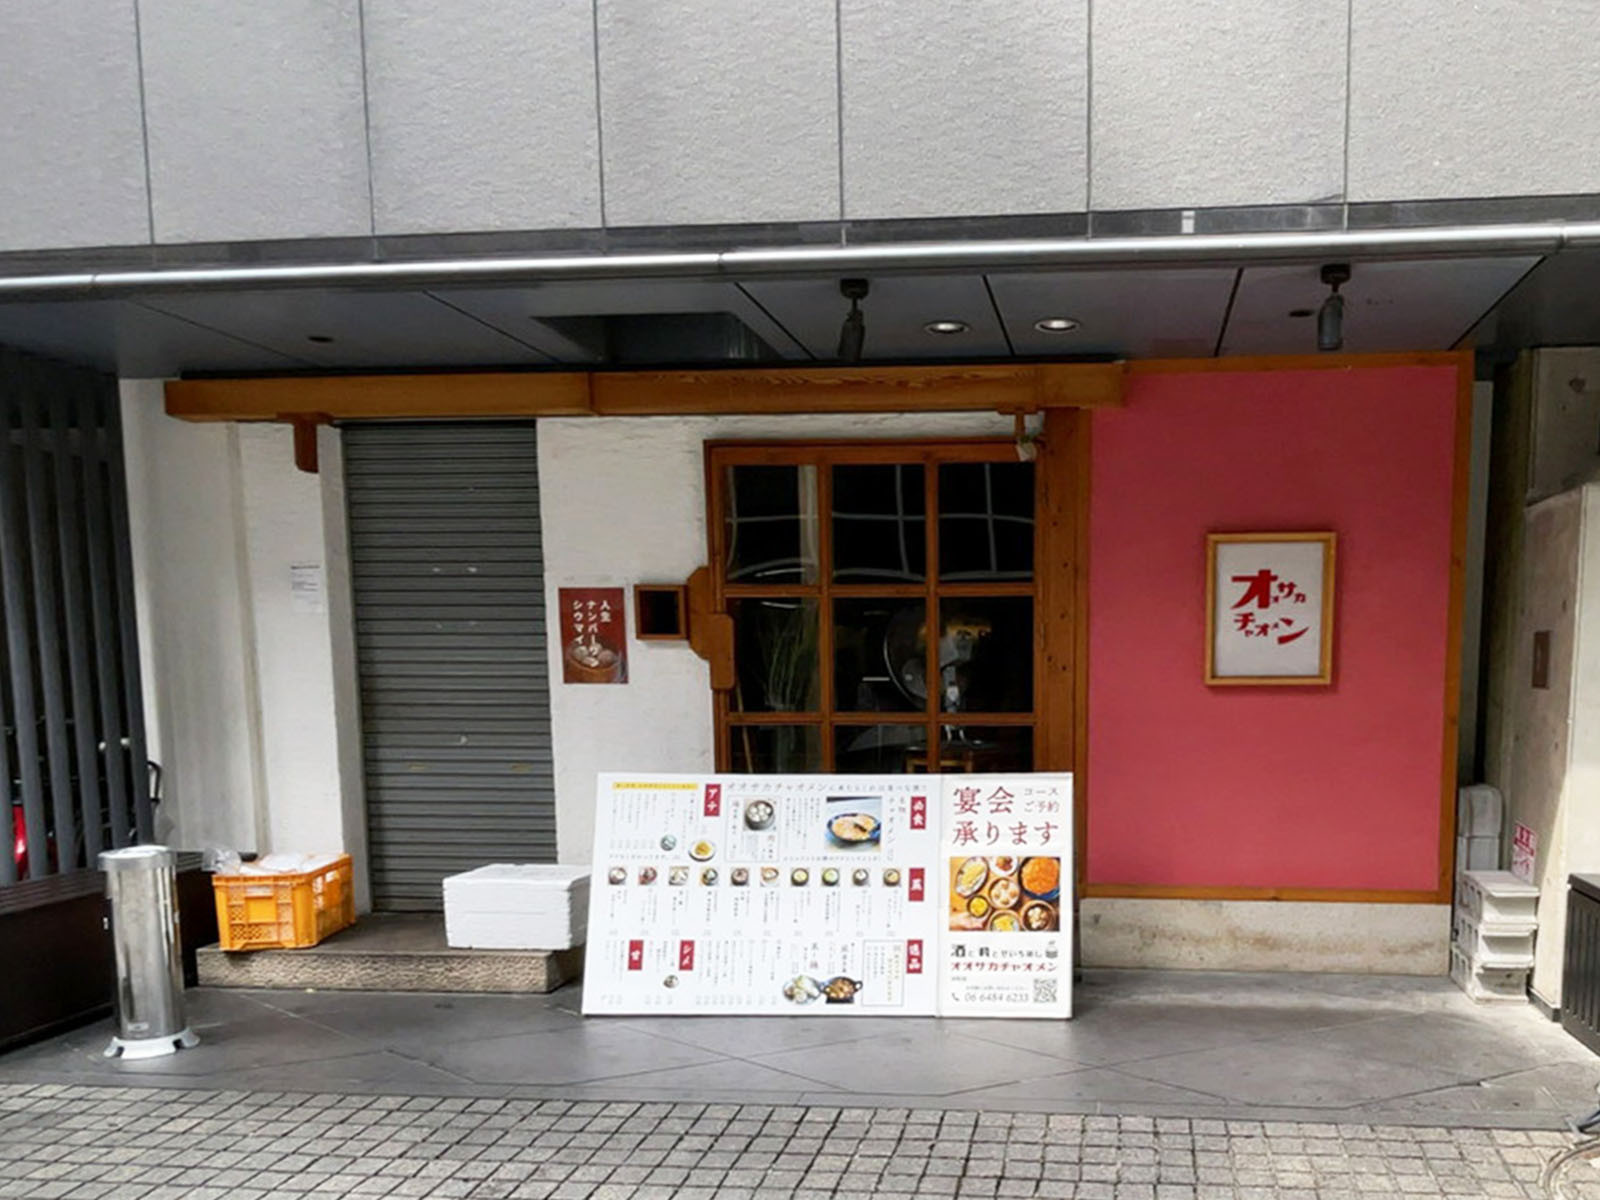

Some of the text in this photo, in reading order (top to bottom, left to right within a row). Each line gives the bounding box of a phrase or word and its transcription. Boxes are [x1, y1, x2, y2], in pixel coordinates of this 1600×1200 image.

[953, 786, 1015, 815] 宴会
[1024, 787, 1059, 796] コース
[1025, 801, 1060, 813] ご予約
[952, 821, 1059, 846] 承ります
